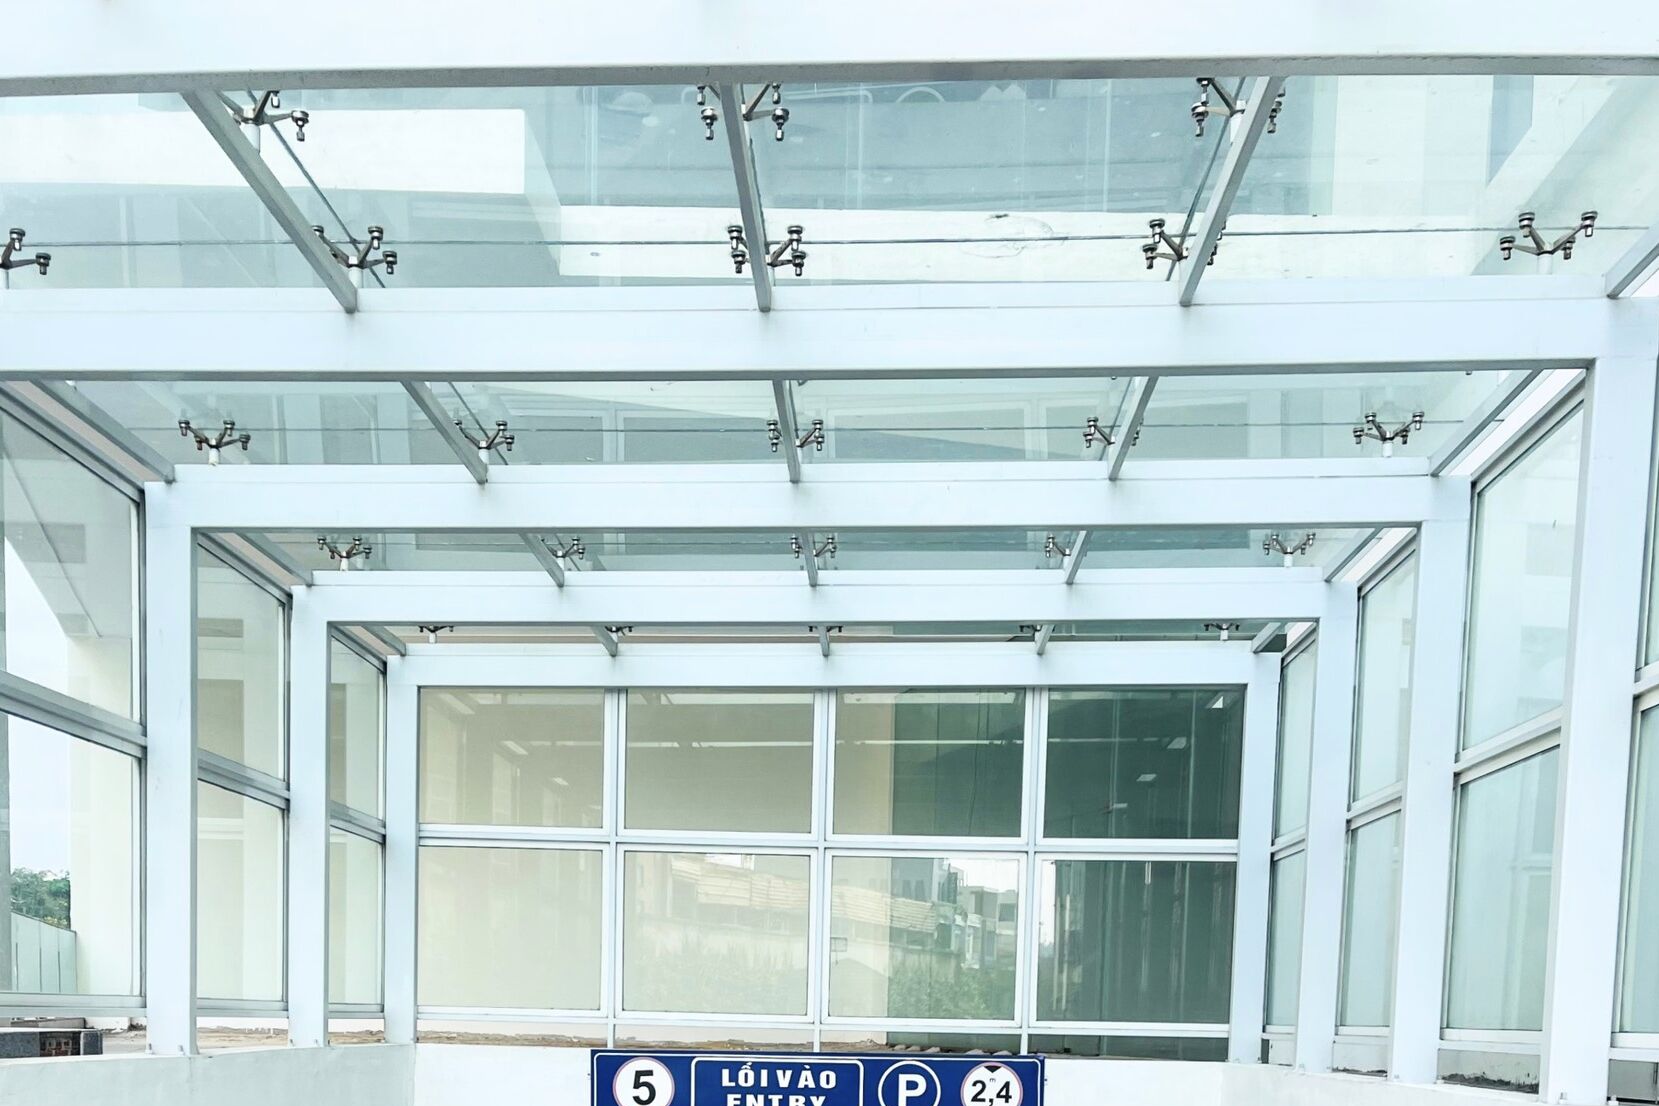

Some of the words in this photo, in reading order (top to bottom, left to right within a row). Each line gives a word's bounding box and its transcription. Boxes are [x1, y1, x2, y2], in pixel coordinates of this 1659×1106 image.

[632, 1069, 656, 1106] 5
[721, 1061, 768, 1088] LỐI
[776, 1064, 837, 1089] VÀO
